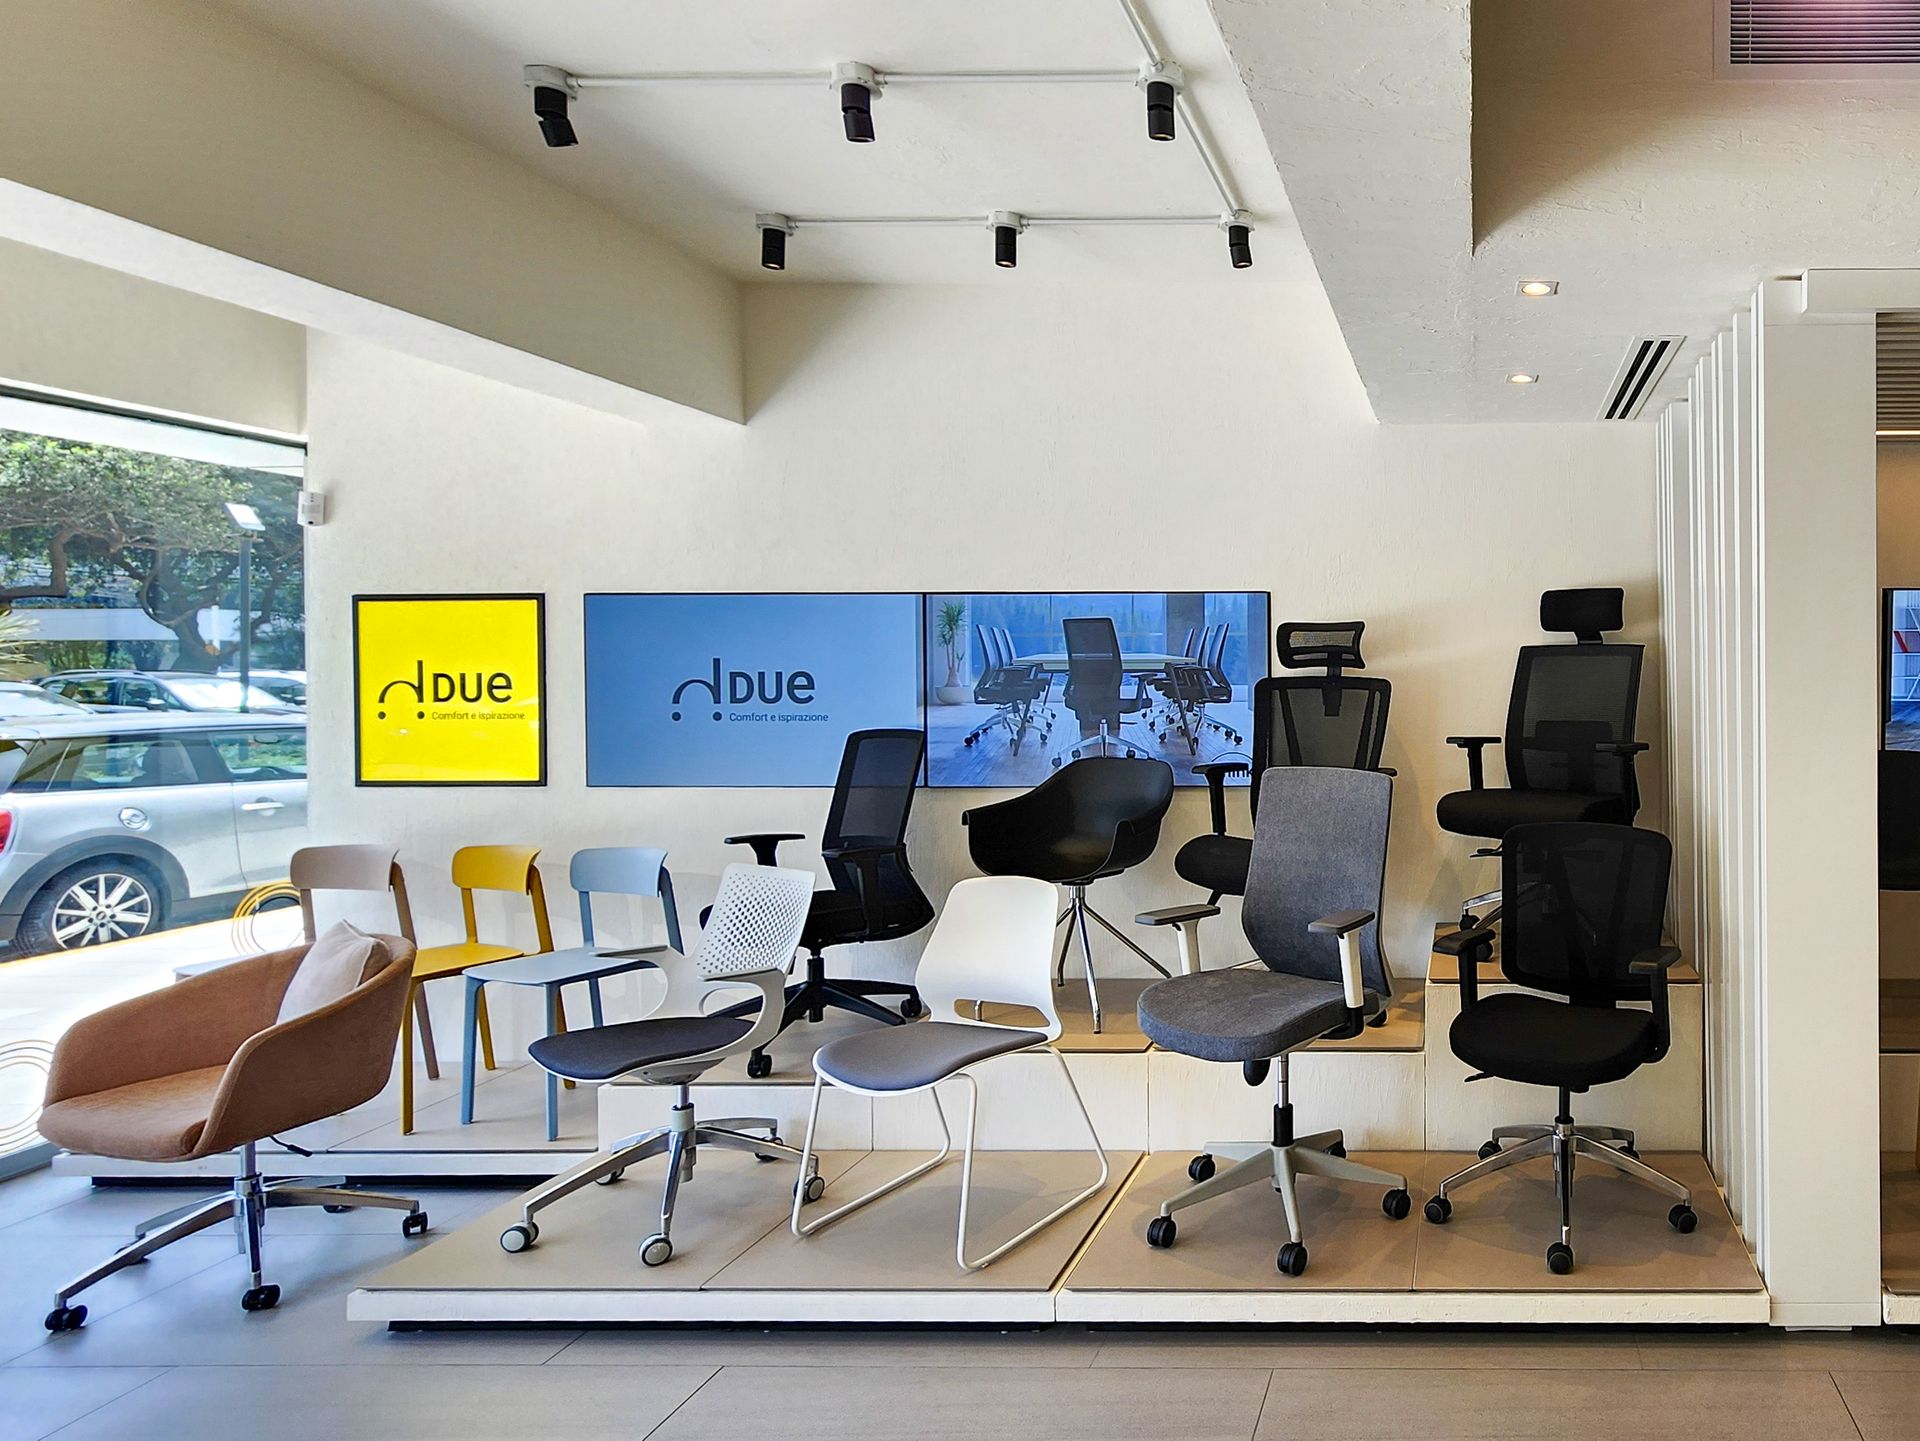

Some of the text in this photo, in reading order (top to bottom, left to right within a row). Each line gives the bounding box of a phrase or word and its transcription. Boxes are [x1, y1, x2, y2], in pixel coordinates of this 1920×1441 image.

[432, 711, 469, 720] Comfort
[478, 711, 525, 721] ispirazione
[729, 712, 829, 724] Comfort e ispirazione
